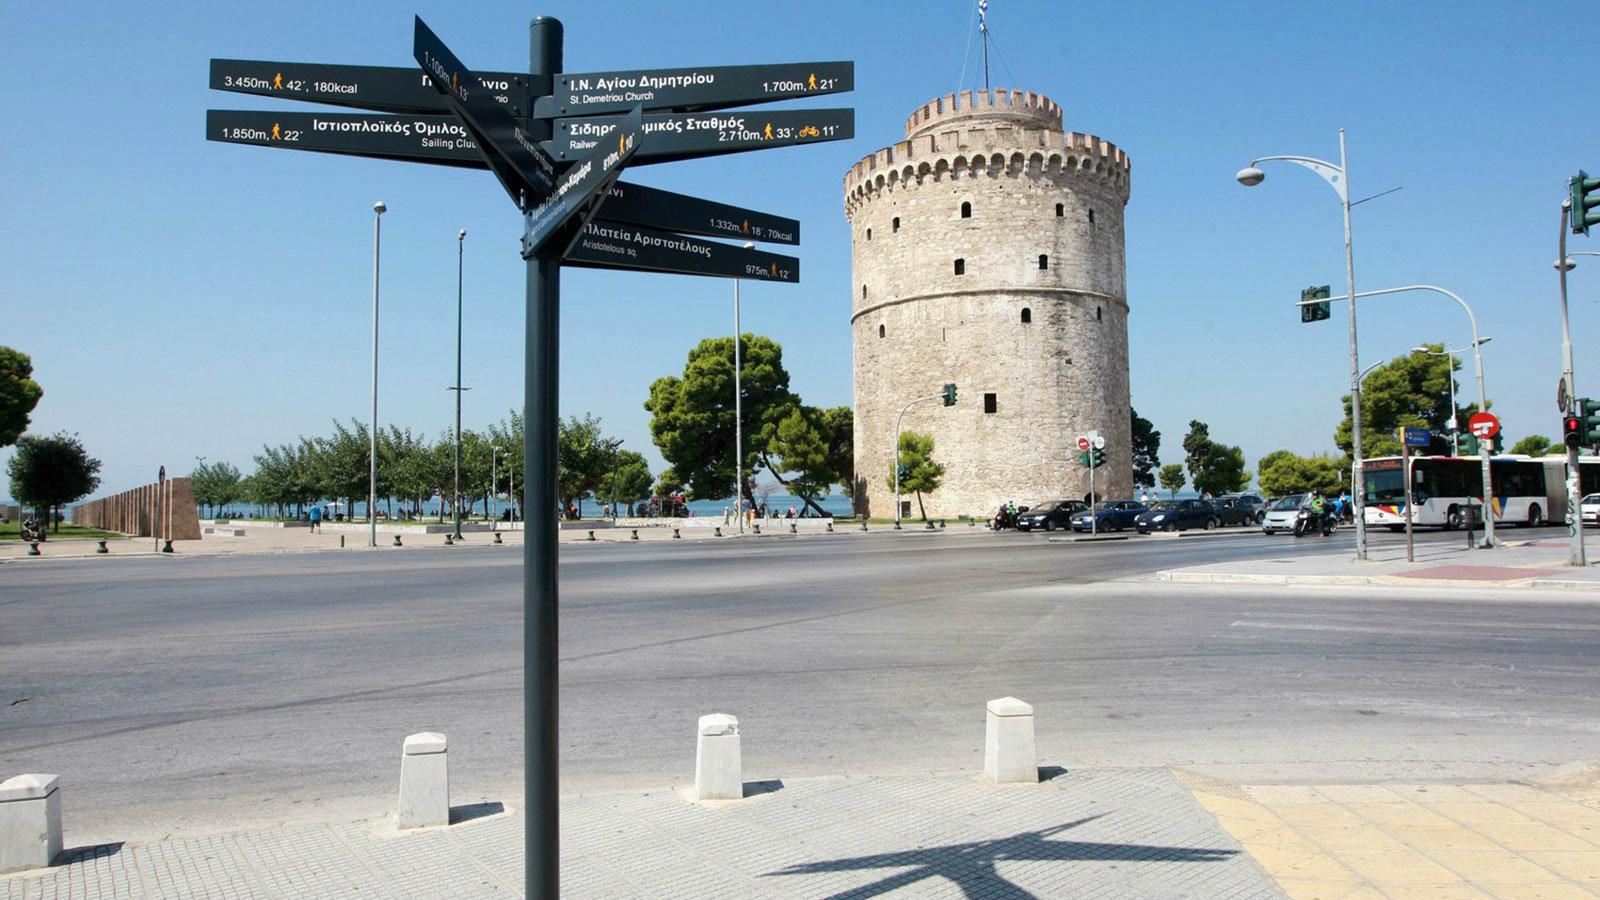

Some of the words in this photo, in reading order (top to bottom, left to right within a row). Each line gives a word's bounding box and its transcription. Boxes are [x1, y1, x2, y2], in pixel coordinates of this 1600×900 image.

[224, 76, 272, 90] 3.450m,
[313, 82, 358, 94] 180kcal
[597, 77, 636, 91] Αγίου
[639, 73, 714, 89] Δημητρίου
[762, 81, 807, 92] 1.700m,
[570, 95, 581, 104] St.
[583, 93, 623, 104] Demetriou
[625, 91, 654, 101] Church
[313, 118, 410, 136] Ιστιοπλοϊκός
[414, 121, 466, 137] Όμιλος
[686, 116, 745, 131] Σταθμός
[222, 128, 270, 141] 1.850m,
[719, 130, 763, 142] 2.710m,
[421, 137, 454, 150] Sailing
[710, 218, 742, 233] 1.332m,
[768, 229, 792, 241] 70kcal
[583, 223, 632, 241] Πλατεία
[634, 232, 712, 257] Αριστοτέλους
[746, 264, 770, 277] 975m,
